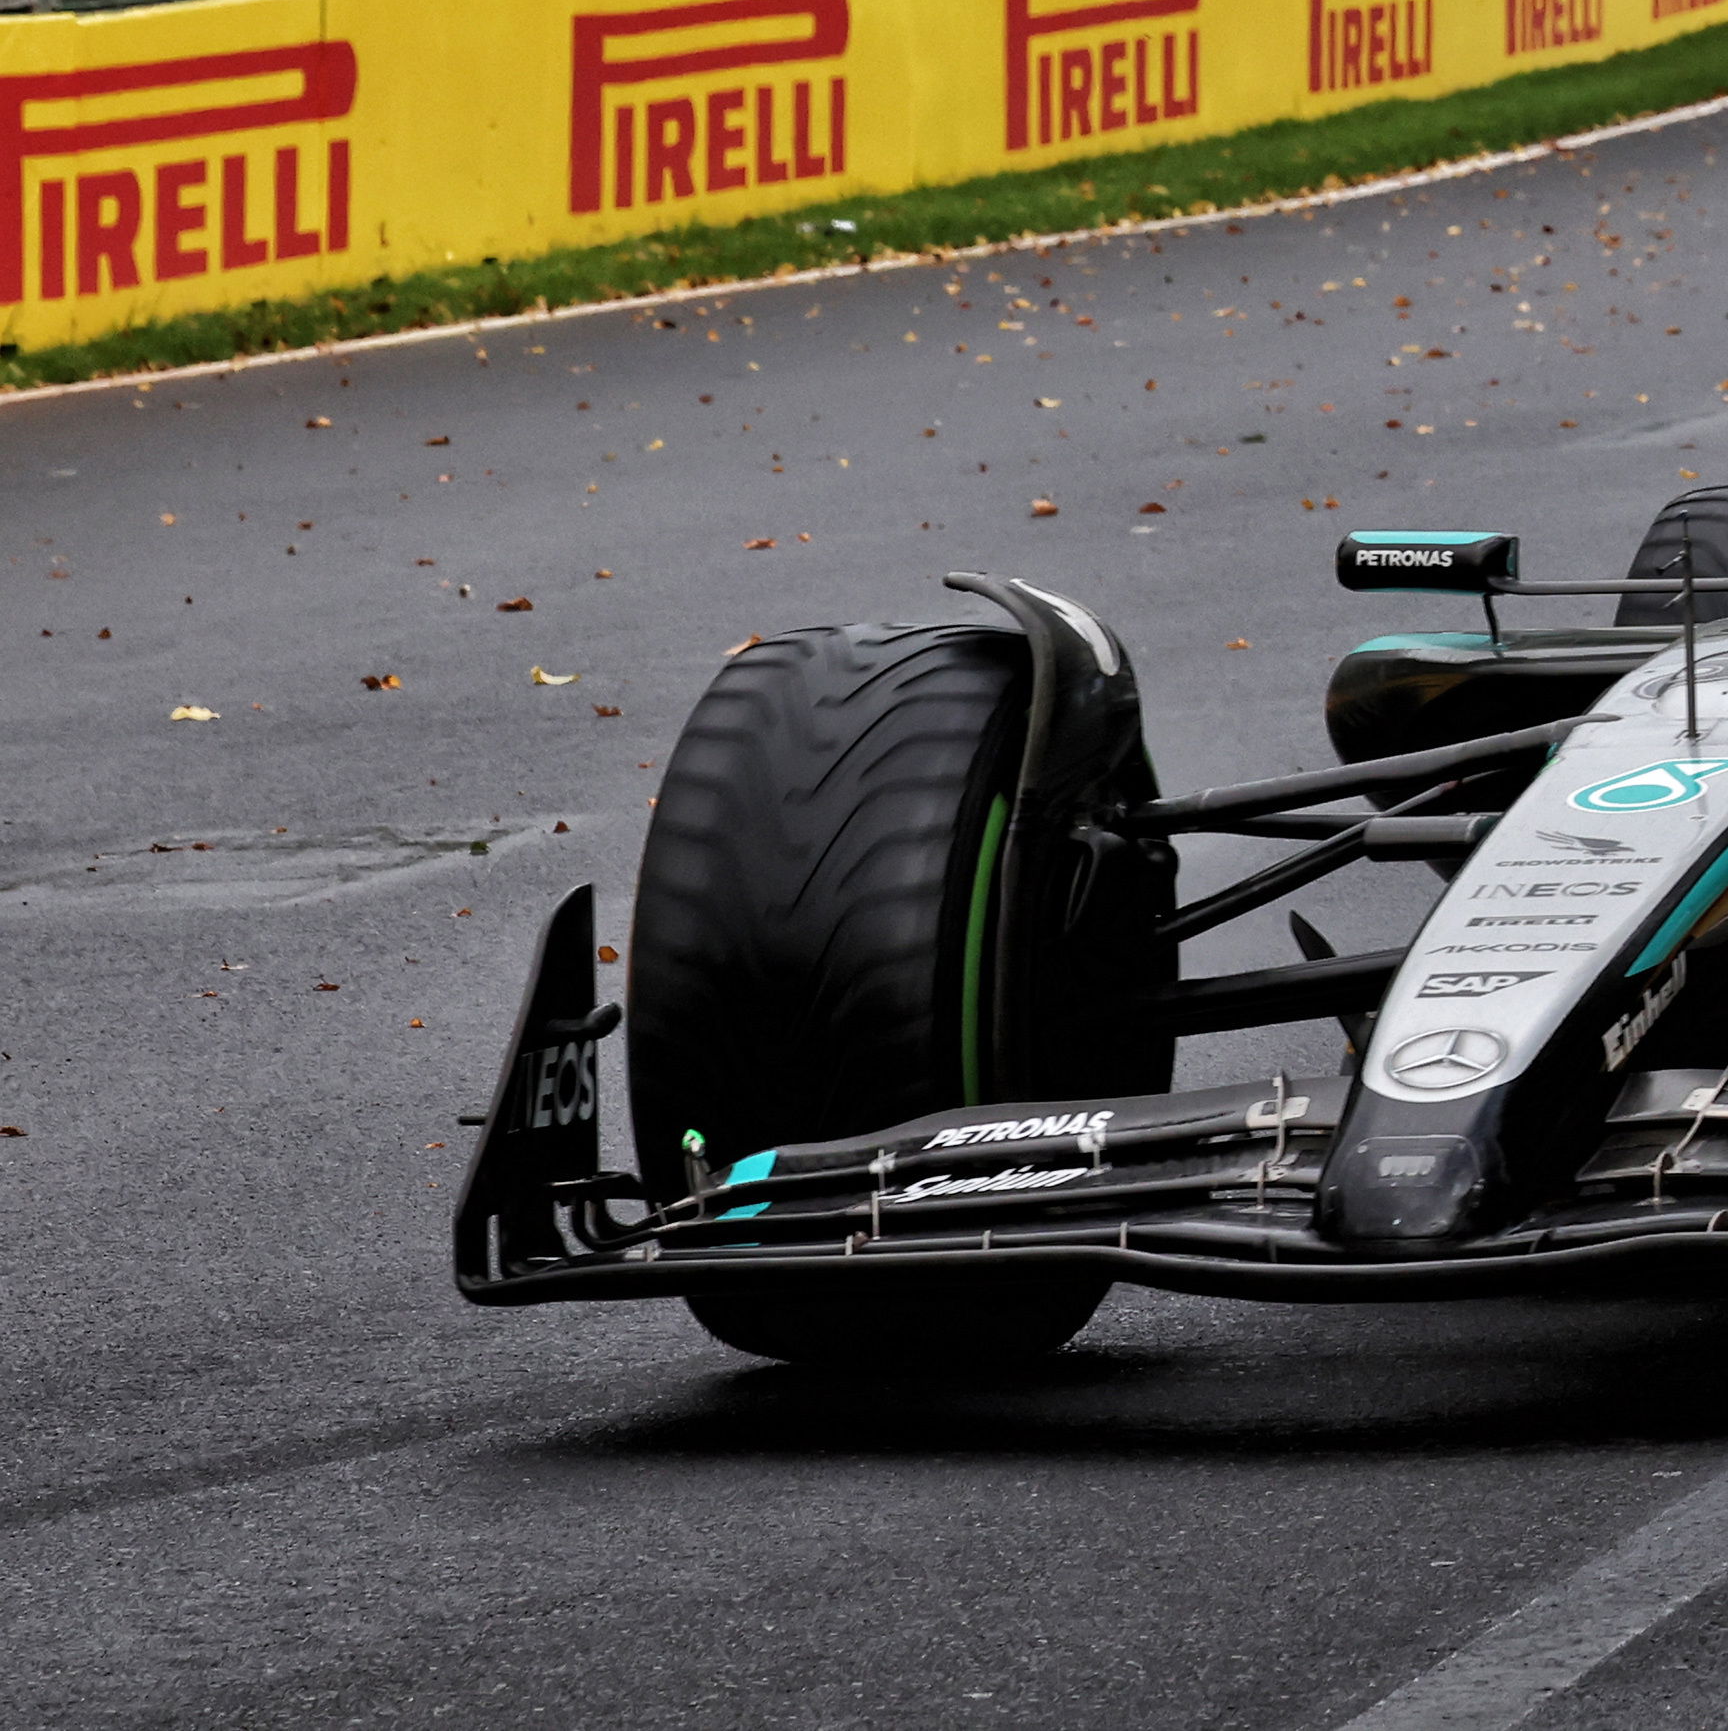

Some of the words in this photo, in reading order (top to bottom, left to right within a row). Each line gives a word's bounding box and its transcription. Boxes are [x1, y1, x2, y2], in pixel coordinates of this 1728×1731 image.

[0, 41, 357, 305] PIRELLI
[1356, 550, 1454, 567] PETRONAS
[1496, 857, 1663, 867] CROWDSTRIKE
[1468, 881, 1643, 900] INEOS
[1420, 974, 1521, 994] SAP
[922, 1111, 1114, 1150] PETRONAS
